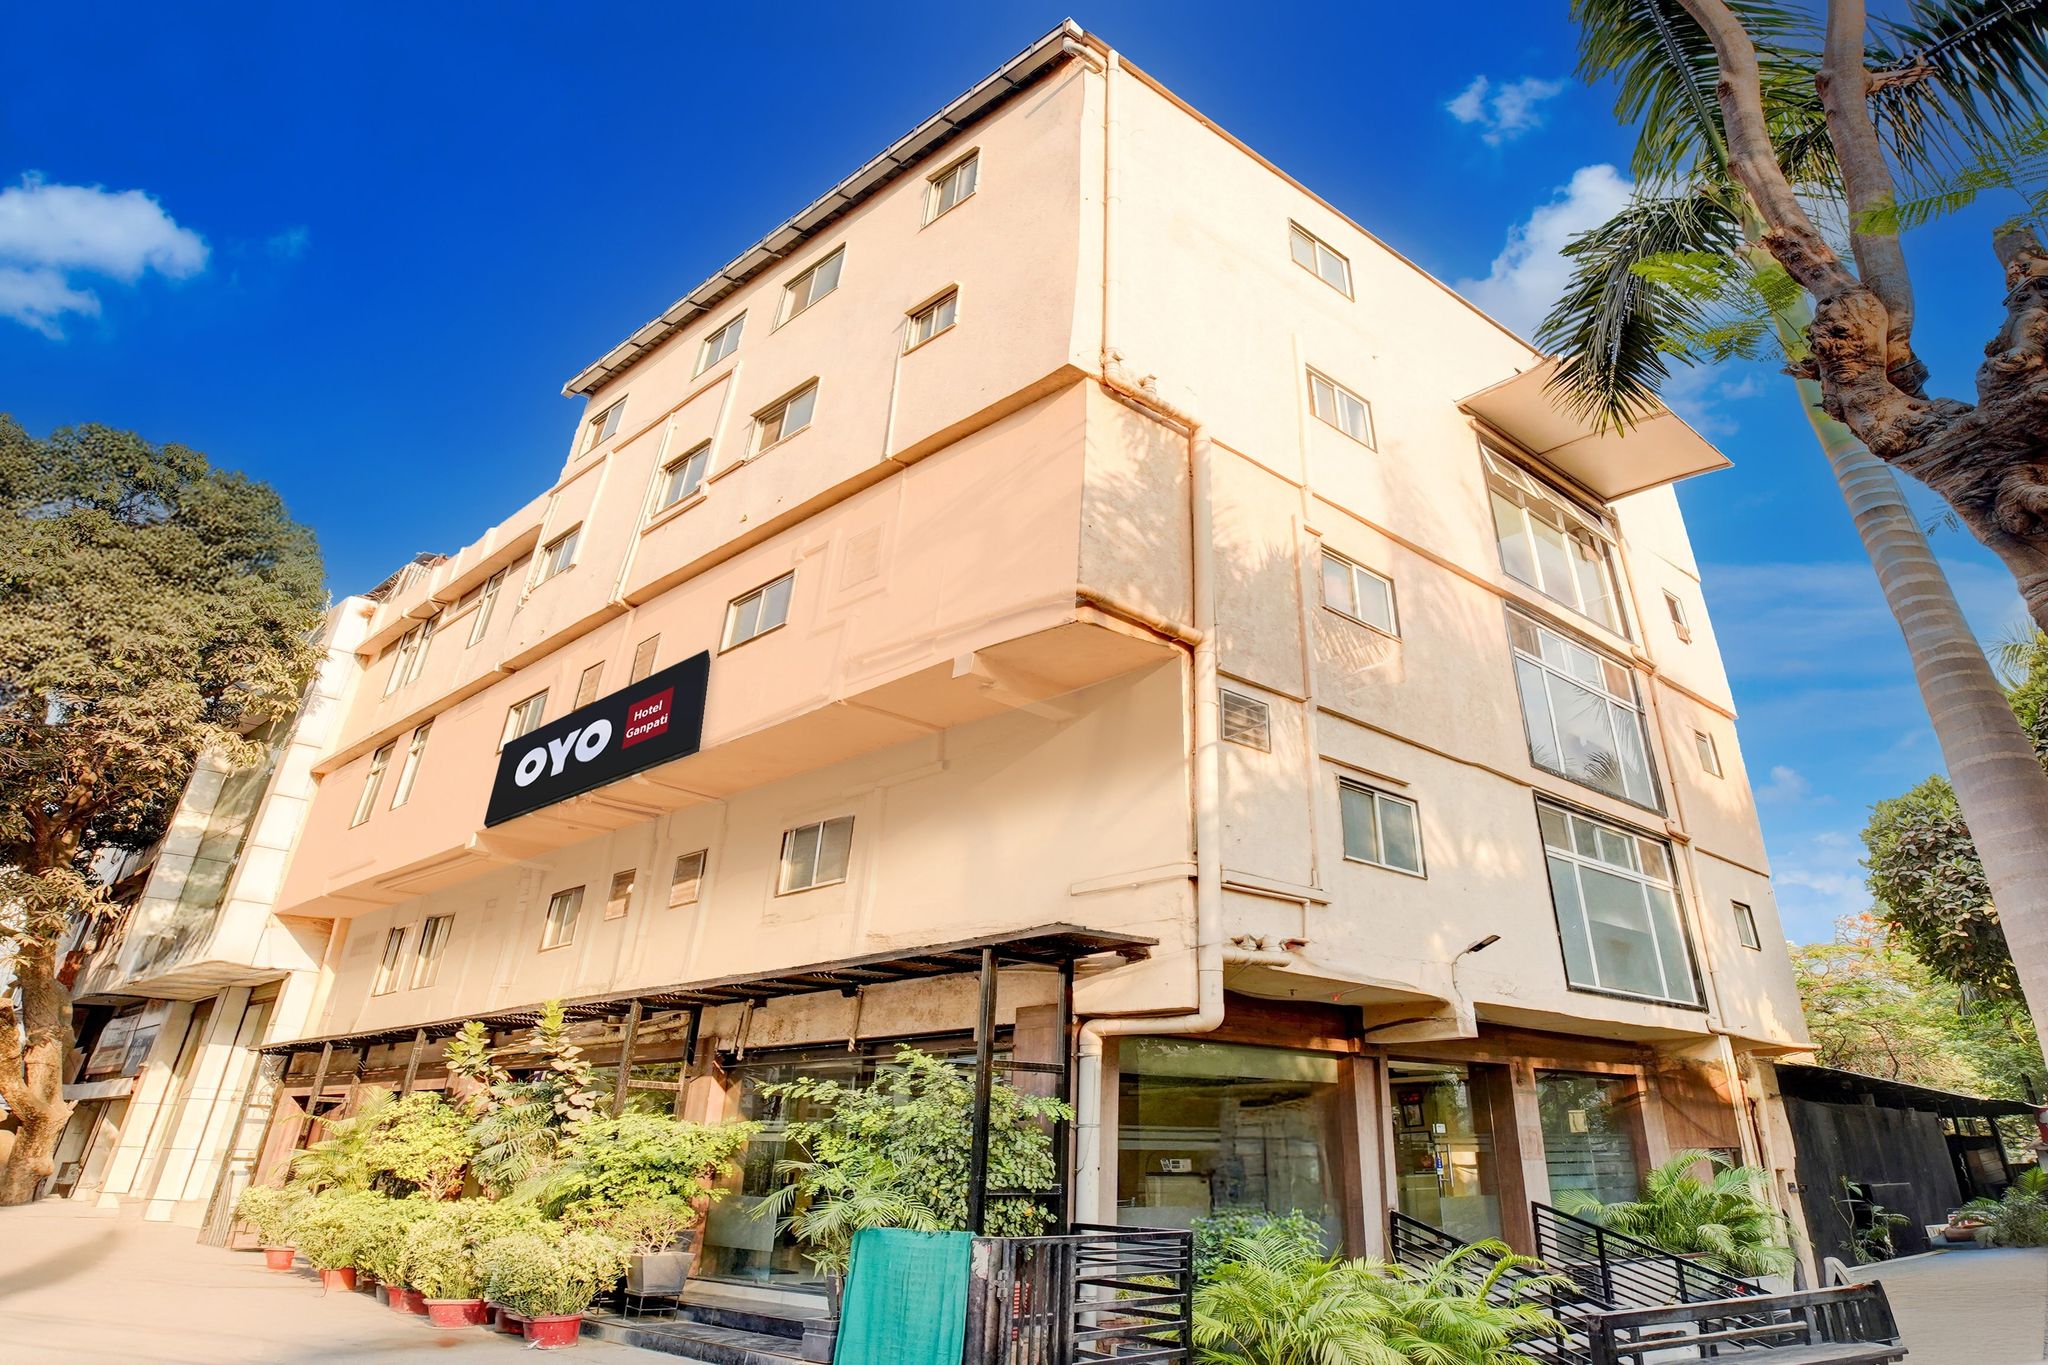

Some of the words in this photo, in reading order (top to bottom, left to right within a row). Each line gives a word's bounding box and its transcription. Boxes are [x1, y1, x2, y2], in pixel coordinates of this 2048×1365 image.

[633, 699, 663, 721] Hotel
[625, 713, 668, 739] Ganpati
[514, 719, 613, 788] OYO
